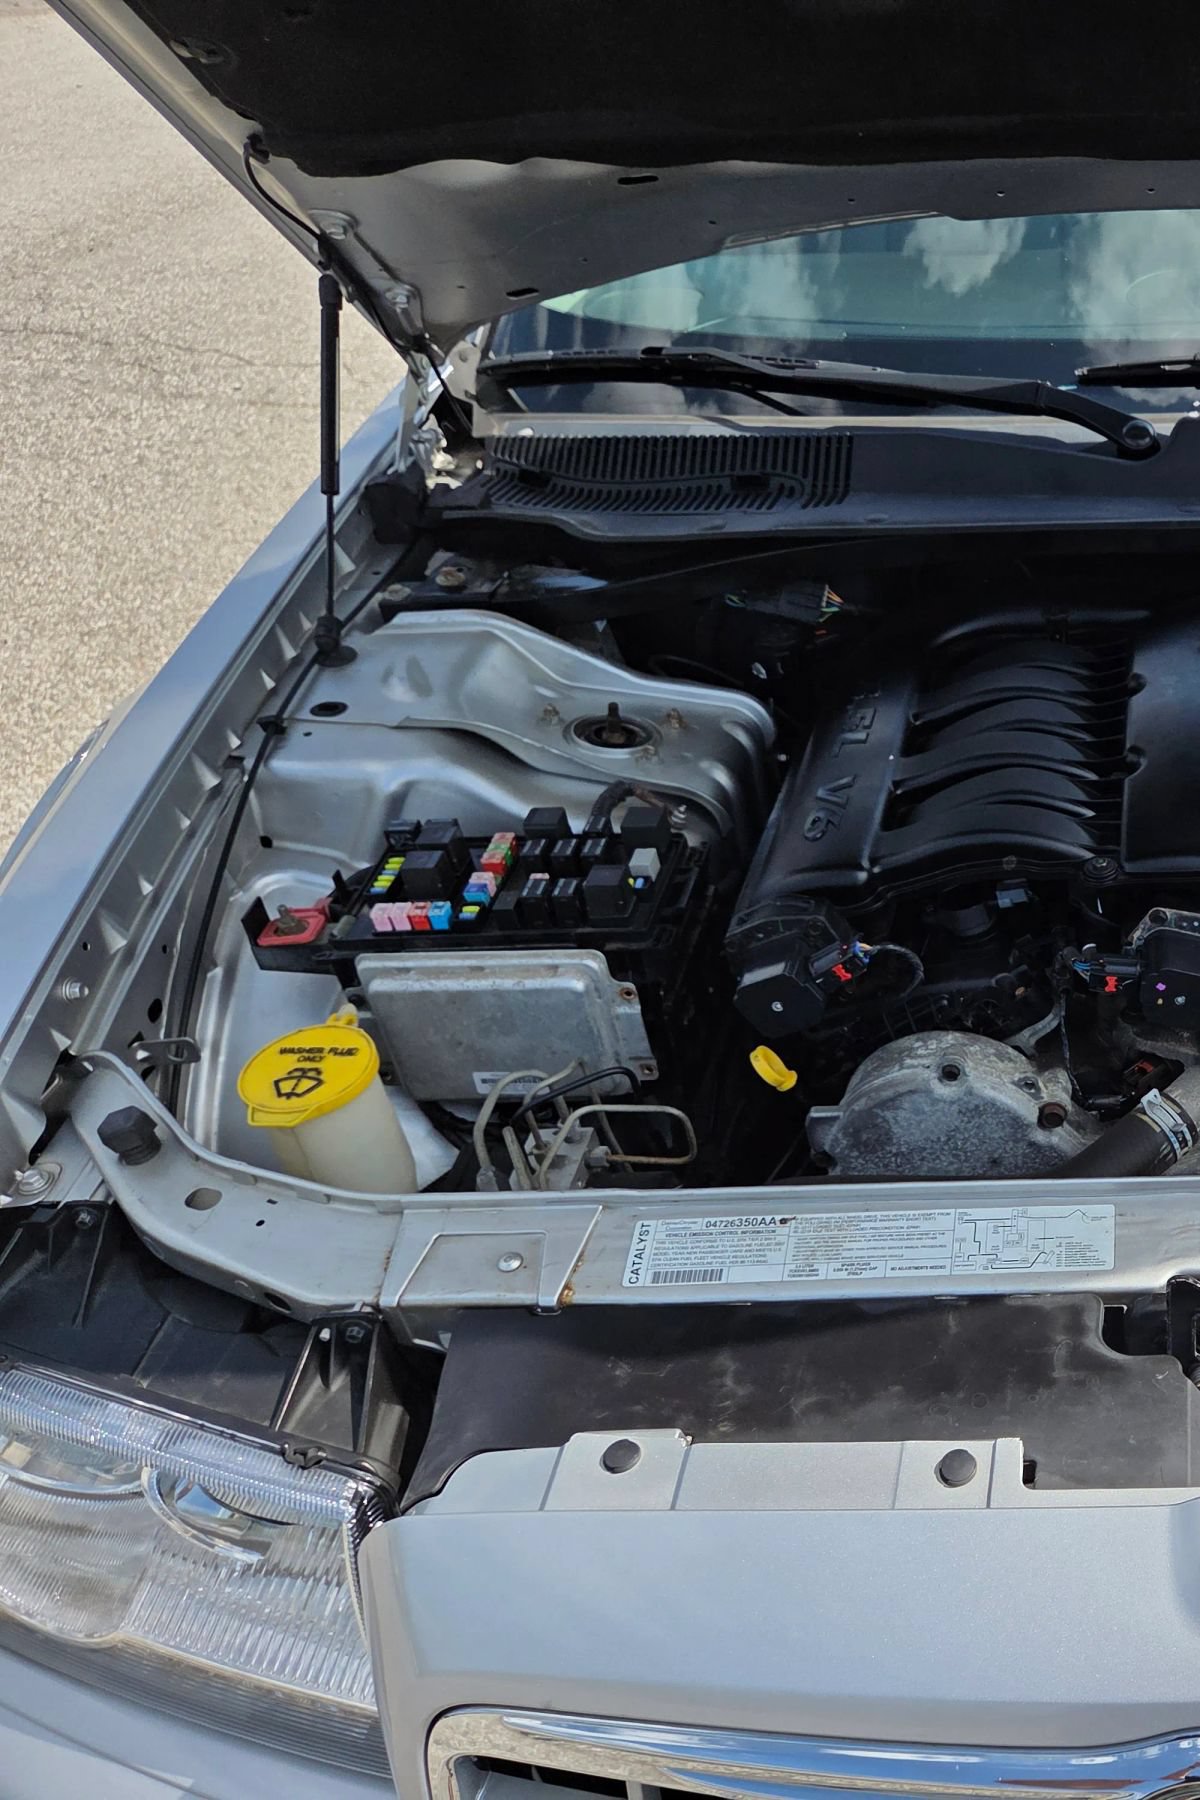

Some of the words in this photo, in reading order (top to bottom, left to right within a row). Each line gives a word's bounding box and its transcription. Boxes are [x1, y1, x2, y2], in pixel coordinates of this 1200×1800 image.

[803, 773, 857, 842] V6
[279, 1047, 325, 1055] WASHER
[327, 1047, 360, 1056] FLUID
[297, 1055, 326, 1063] ONLY
[705, 1217, 777, 1228] 04726350AA
[628, 1222, 651, 1285] CATALYST
